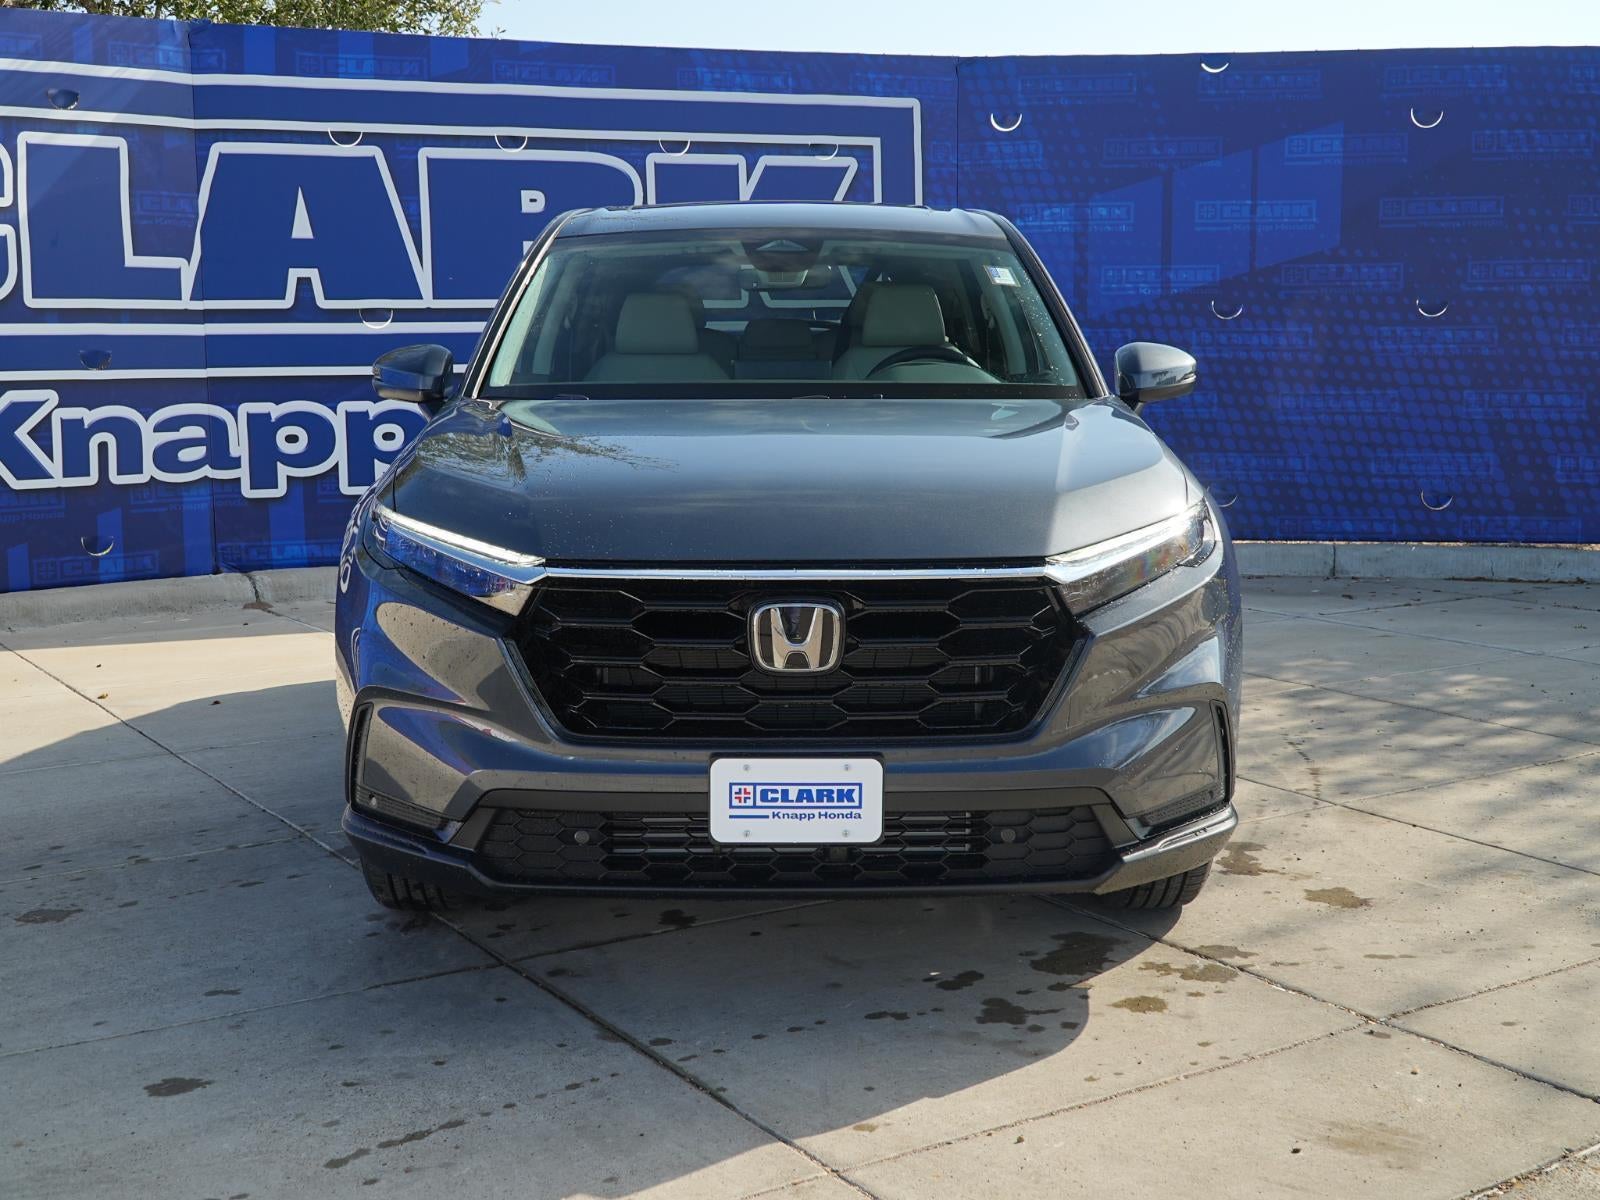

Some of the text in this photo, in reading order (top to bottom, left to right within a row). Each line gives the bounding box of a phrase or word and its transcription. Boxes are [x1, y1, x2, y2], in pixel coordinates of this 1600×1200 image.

[0, 131, 858, 310] LARK
[0, 389, 431, 499] Knapp
[759, 788, 856, 803] CLARK
[772, 811, 862, 821] Knapp Honda
